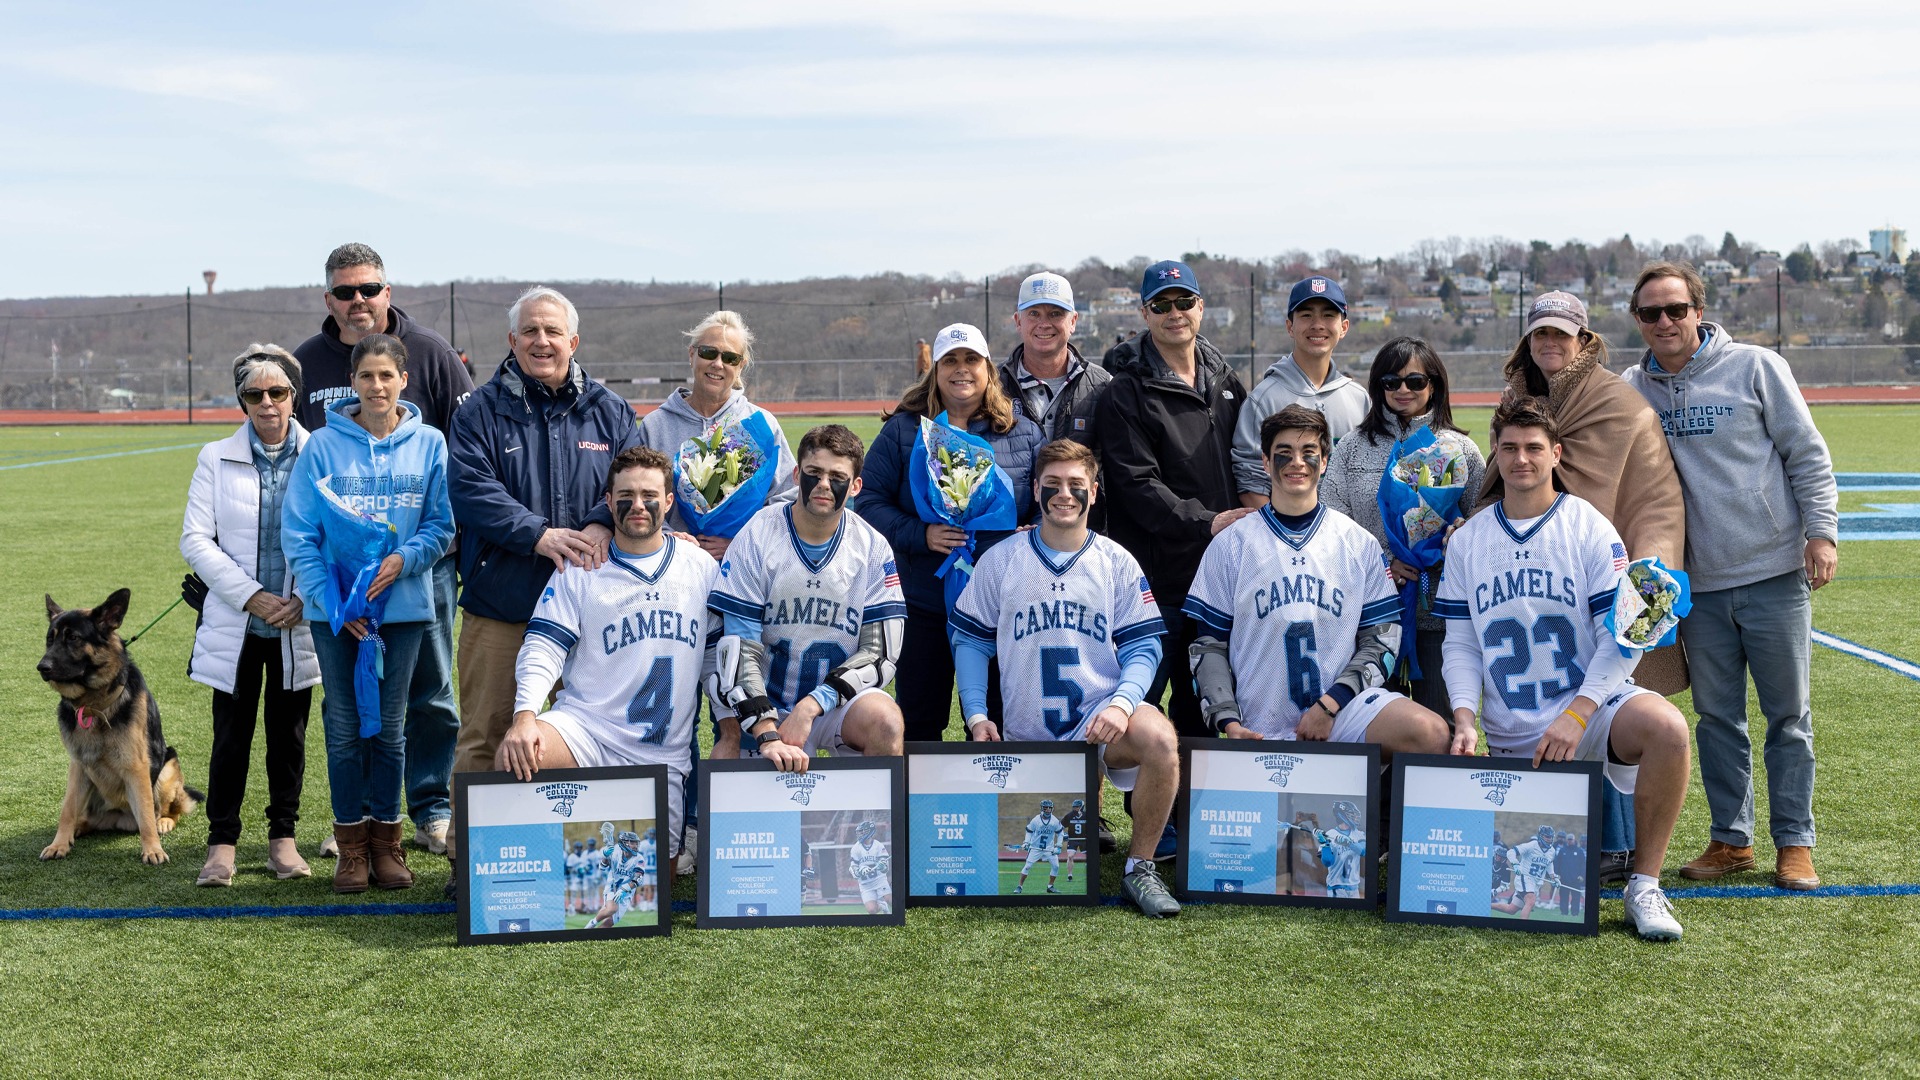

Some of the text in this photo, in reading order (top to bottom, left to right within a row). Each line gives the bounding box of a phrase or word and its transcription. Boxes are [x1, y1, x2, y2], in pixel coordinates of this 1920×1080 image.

[578, 441, 609, 451] UCONN
[1254, 574, 1345, 620] CAMELS
[1475, 568, 1576, 615] CAMELS
[762, 597, 860, 637] CAMELS
[1013, 600, 1108, 643] CAMELS
[601, 609, 699, 656] CAMELS
[1283, 619, 1323, 711] 6
[1482, 613, 1586, 711] 23
[765, 638, 851, 711] 10
[1039, 645, 1085, 739] 5
[626, 655, 675, 745] 4
[972, 755, 1022, 765] CONNECTICUT
[1254, 754, 1304, 764] CONNECTICUT
[1264, 760, 1295, 768] COLLEGE
[785, 777, 817, 785] COLLEGE
[1470, 771, 1522, 782] CONNECTICUT
[1480, 777, 1512, 785] COLLEGE
[535, 782, 589, 794] CONNECTICUT
[546, 789, 579, 797] COLLEGE
[933, 813, 968, 826] SEAN
[1200, 809, 1261, 823] BRANDON
[937, 828, 964, 840] FOX
[1209, 824, 1252, 837] ALLEN
[1427, 828, 1463, 842] JACK
[731, 832, 775, 845] JARED
[500, 846, 527, 859] GUS
[716, 847, 790, 860] RAINVILLE
[1401, 841, 1489, 859] VENTURELLI
[475, 859, 552, 875] MAZZOCCA
[1421, 872, 1465, 880] CONNECTICUT
[491, 890, 536, 898] CONNECTICUT
[1436, 886, 1469, 894] LACROSSE
